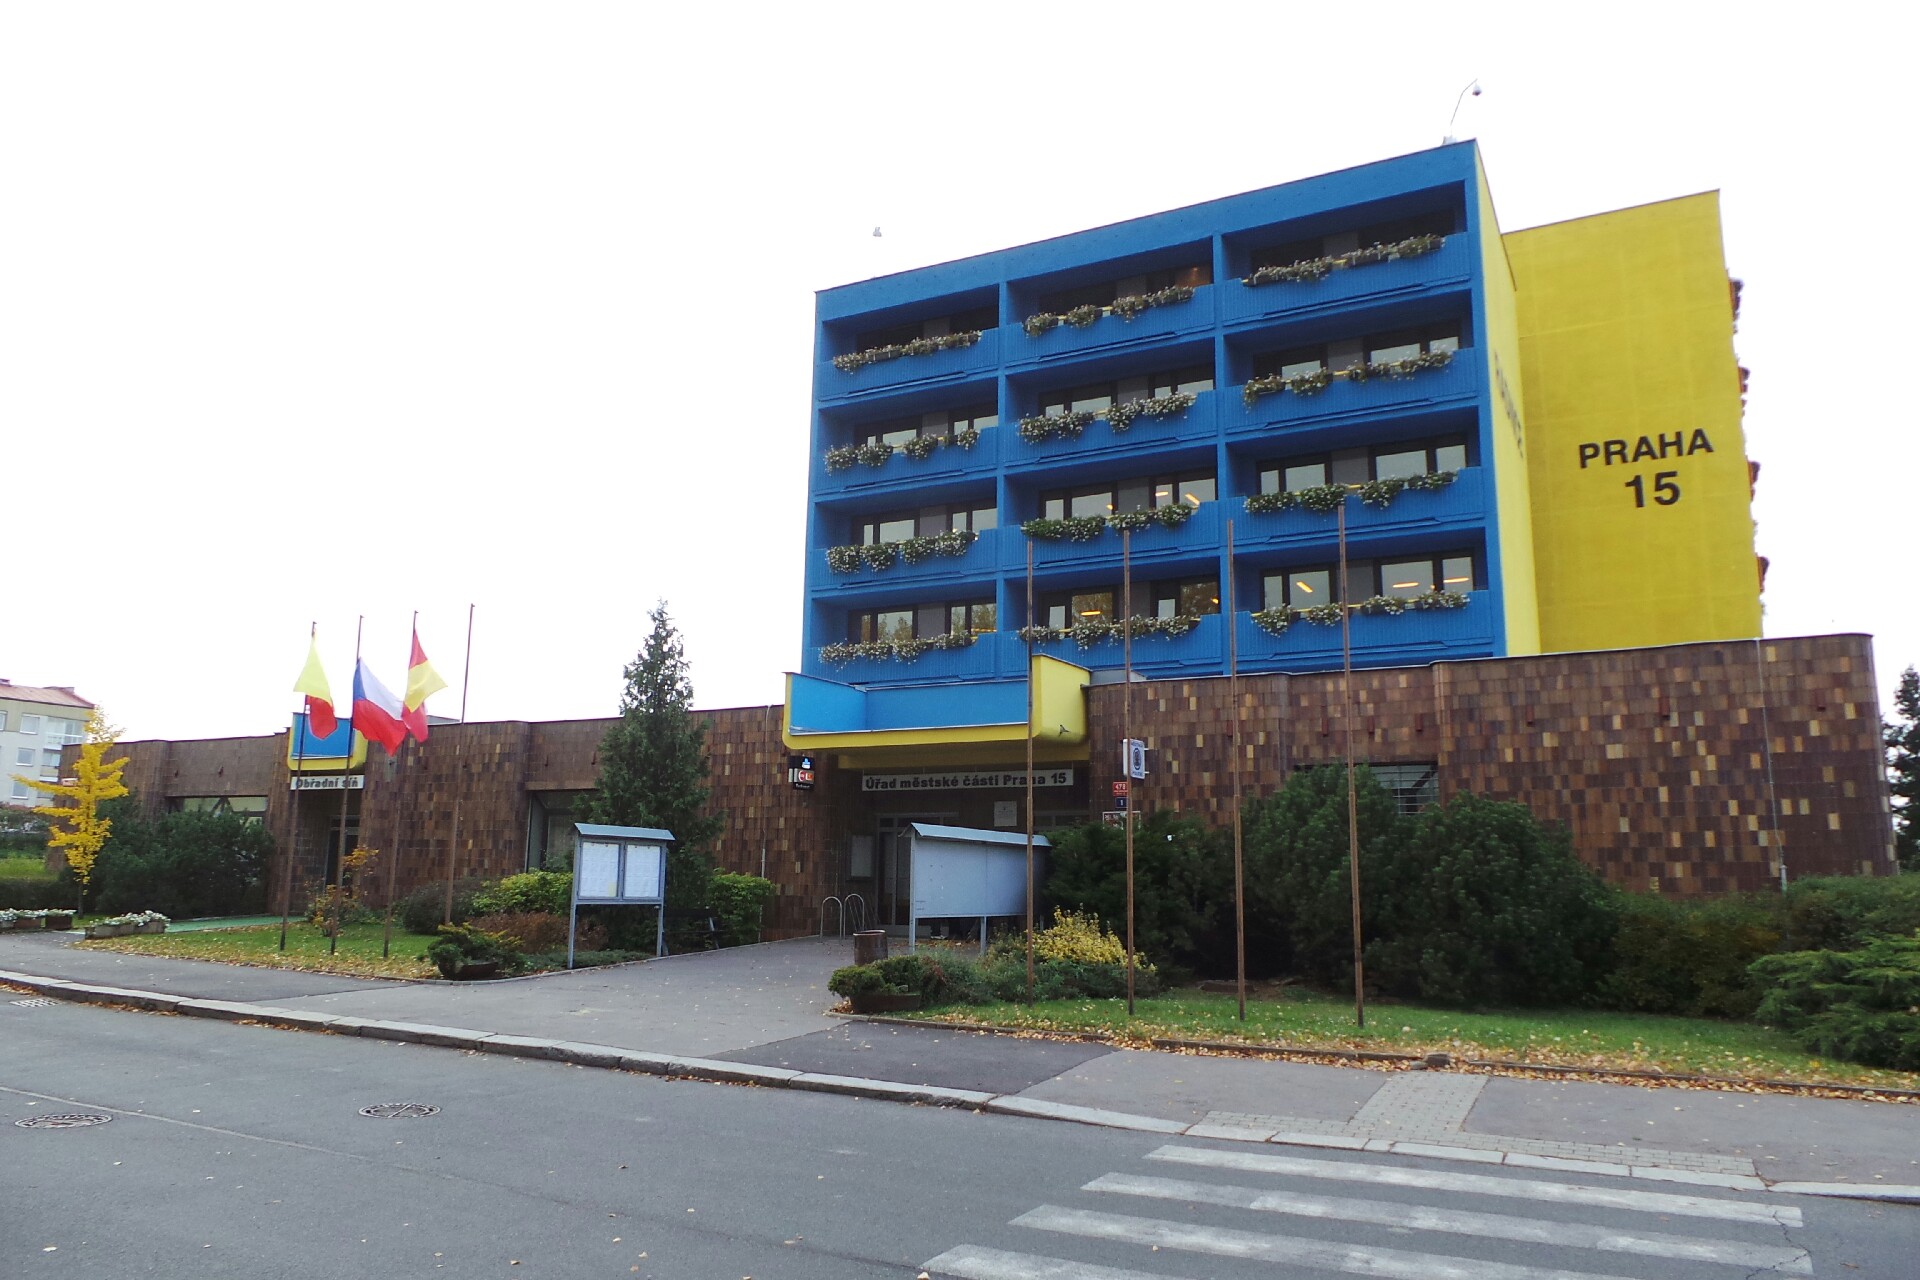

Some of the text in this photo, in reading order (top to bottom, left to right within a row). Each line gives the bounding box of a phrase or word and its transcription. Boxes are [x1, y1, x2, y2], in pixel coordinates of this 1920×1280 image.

[1579, 428, 1714, 469] PRAHA
[1625, 471, 1680, 508] 15
[865, 776, 896, 790] Úřad
[900, 775, 959, 789] městské
[962, 774, 999, 787] části
[1050, 772, 1067, 784] 15
